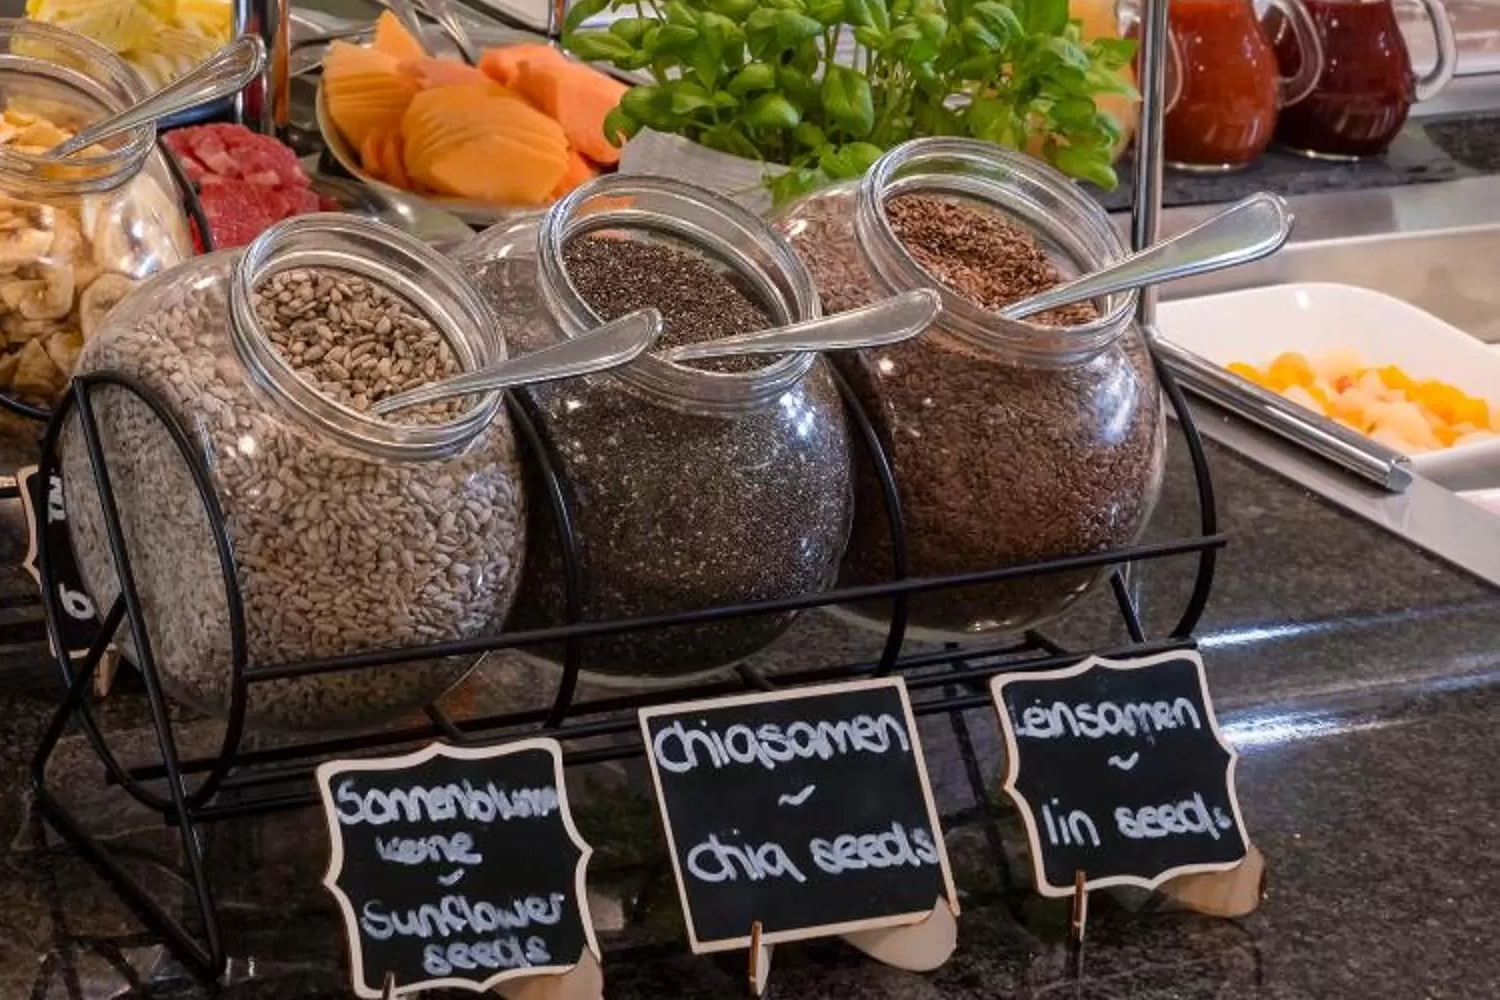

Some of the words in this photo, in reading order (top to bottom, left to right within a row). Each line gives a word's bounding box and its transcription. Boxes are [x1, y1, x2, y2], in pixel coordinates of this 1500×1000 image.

[1113, 791, 1232, 840] seeds
[809, 821, 938, 874] seeds
[422, 936, 552, 976] seeds
